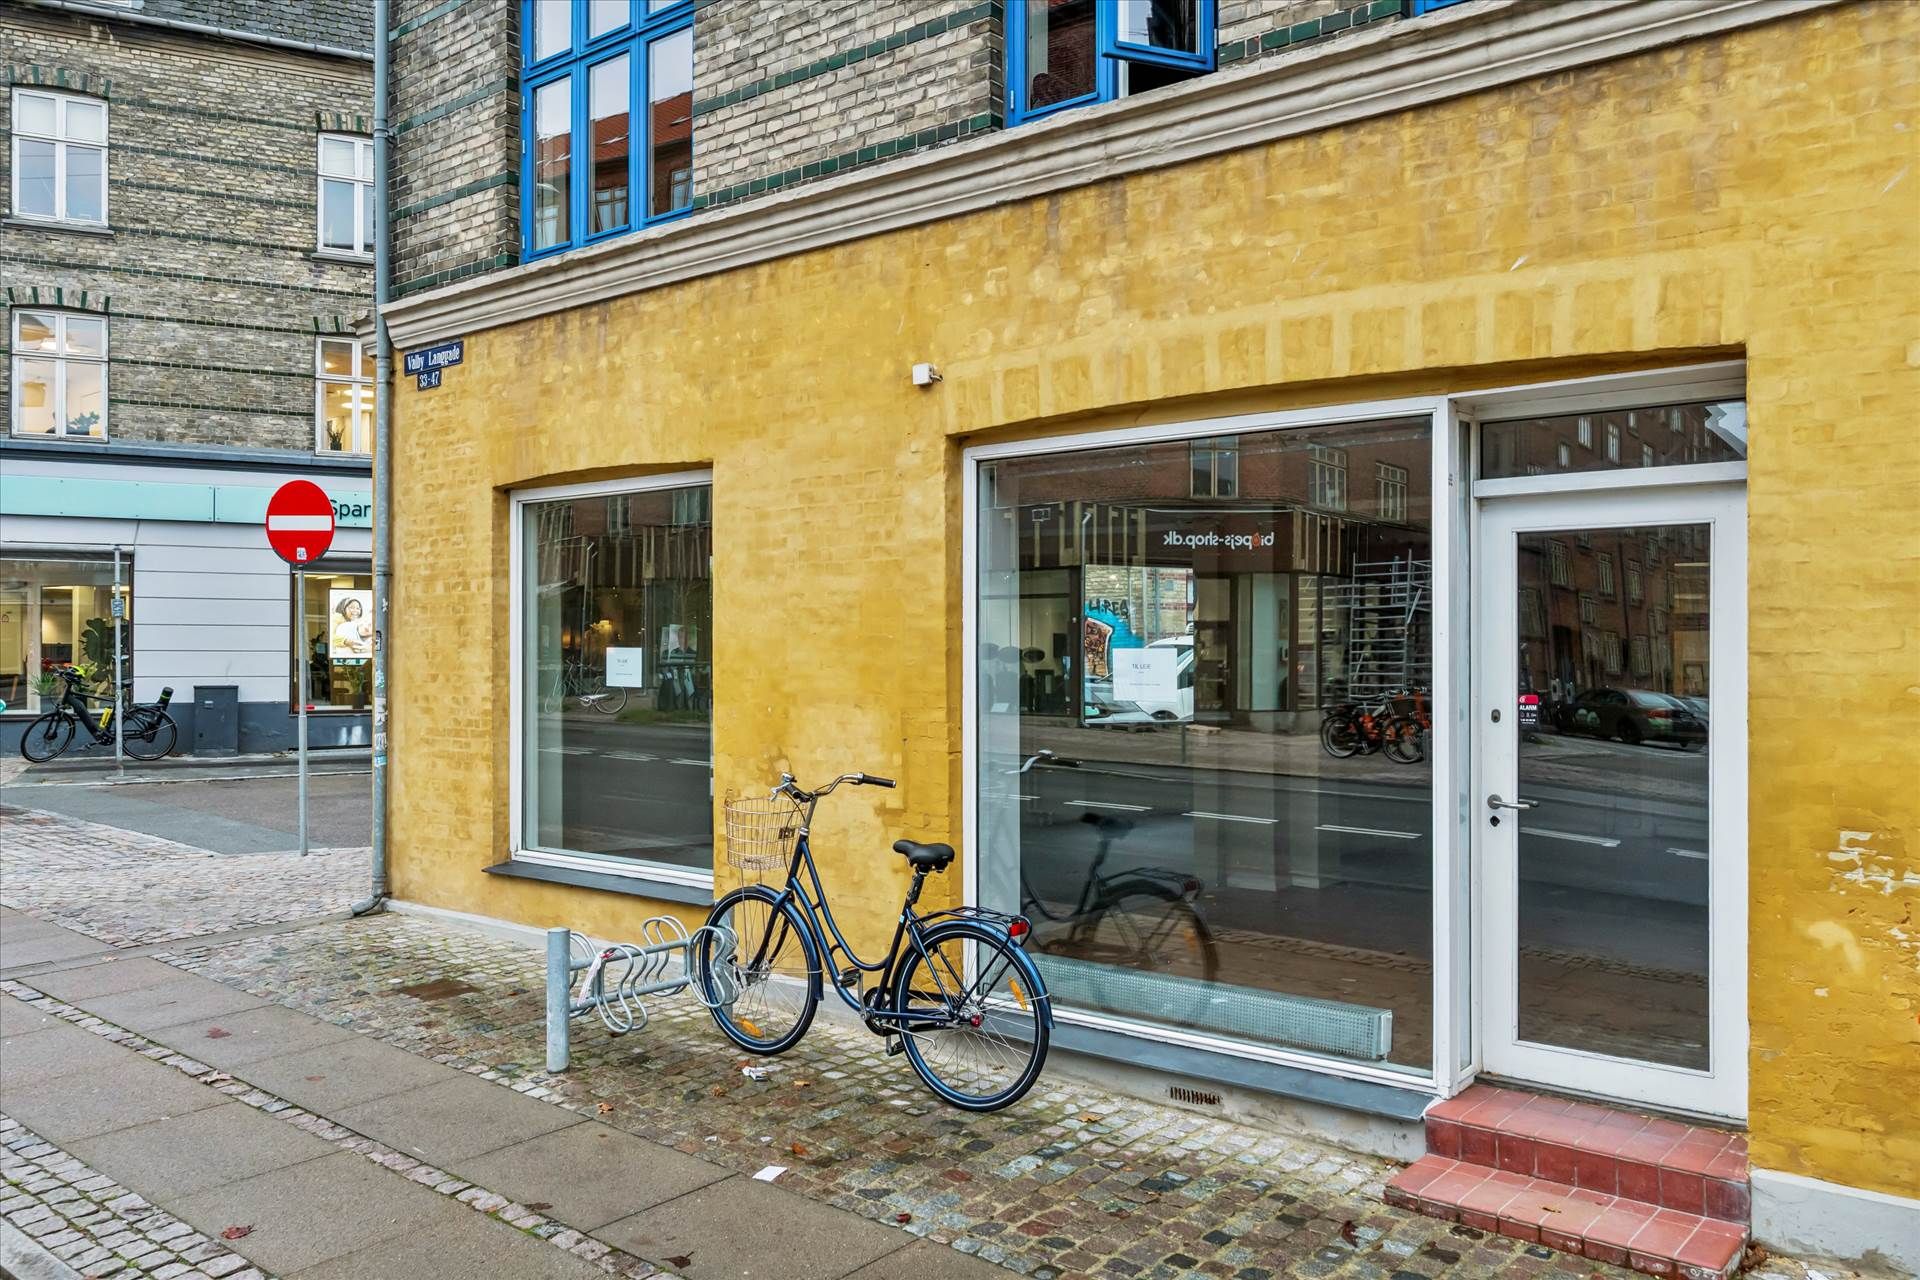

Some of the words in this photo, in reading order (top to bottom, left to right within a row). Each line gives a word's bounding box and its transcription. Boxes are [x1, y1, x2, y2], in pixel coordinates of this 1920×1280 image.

[407, 355, 424, 371] Valby
[428, 345, 460, 366] Langgade
[419, 371, 440, 388] 33-47
